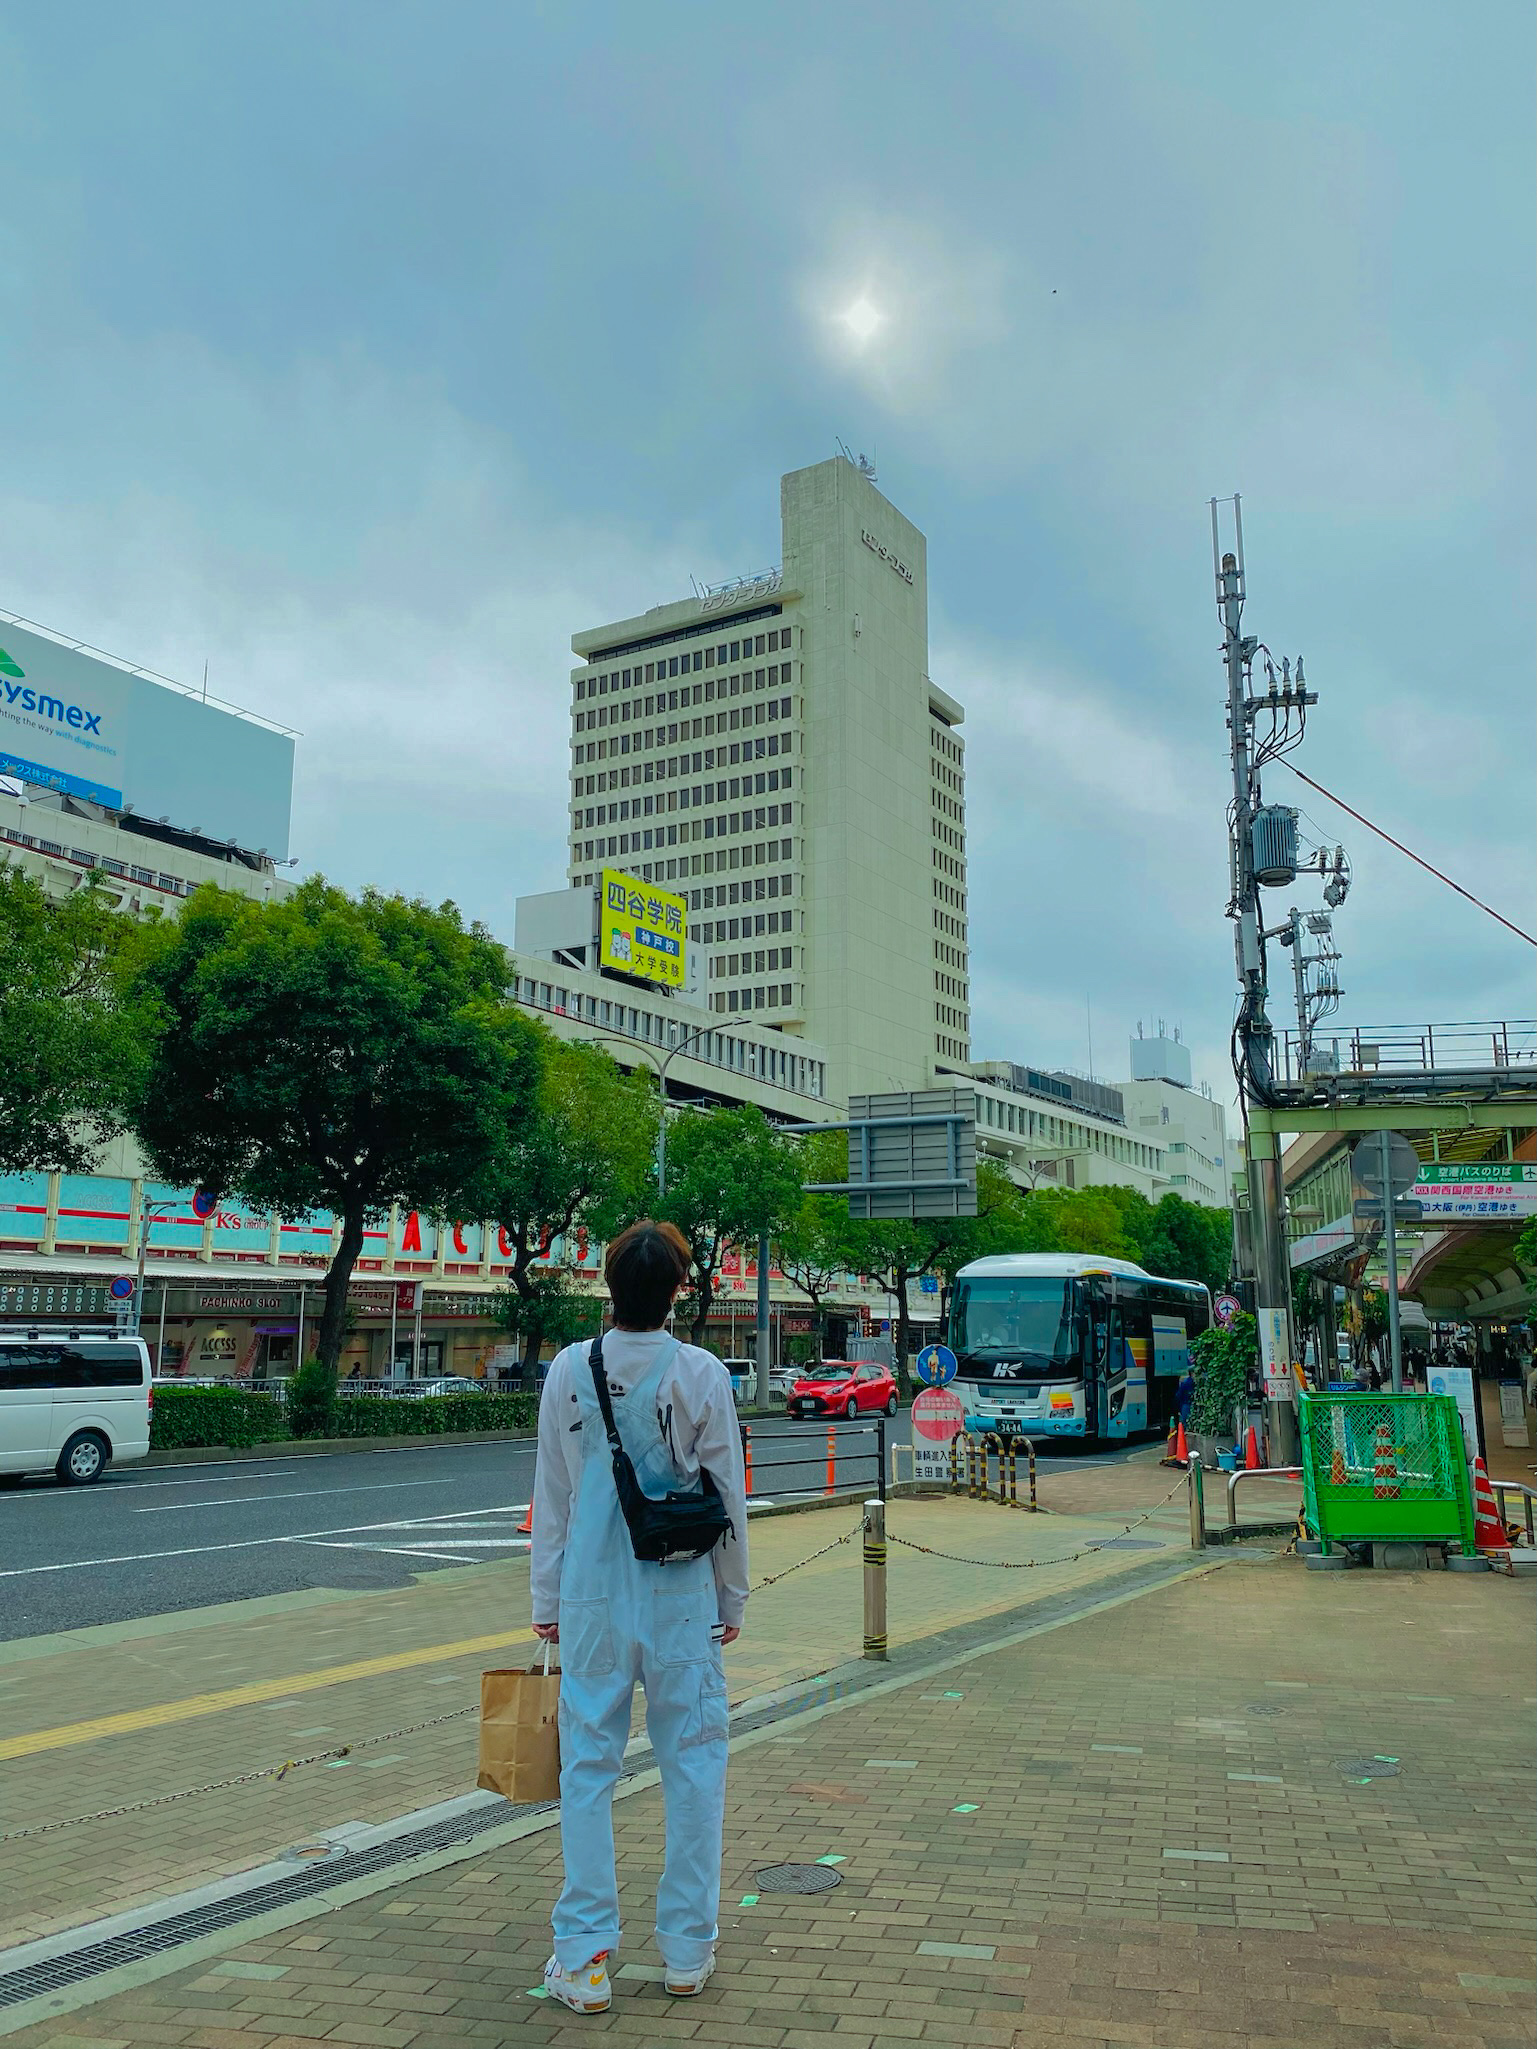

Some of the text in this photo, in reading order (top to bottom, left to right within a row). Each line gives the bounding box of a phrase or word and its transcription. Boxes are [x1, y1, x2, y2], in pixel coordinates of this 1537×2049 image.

[862, 529, 915, 586] センタープラザ
[701, 578, 784, 614] センタープラザ
[0, 679, 101, 736] ysmex
[22, 717, 37, 729] the
[38, 723, 54, 736] way
[55, 730, 74, 741] with
[74, 734, 117, 757] diagnostics
[607, 881, 682, 935] 四谷学院
[640, 929, 676, 955] 神戸校
[635, 951, 680, 979] 大学受験
[1438, 1166, 1513, 1178] 空港バスのりば
[1430, 1185, 1513, 1195] 関西国際空港ゆき
[201, 1297, 282, 1308] PACHINKO SLOT
